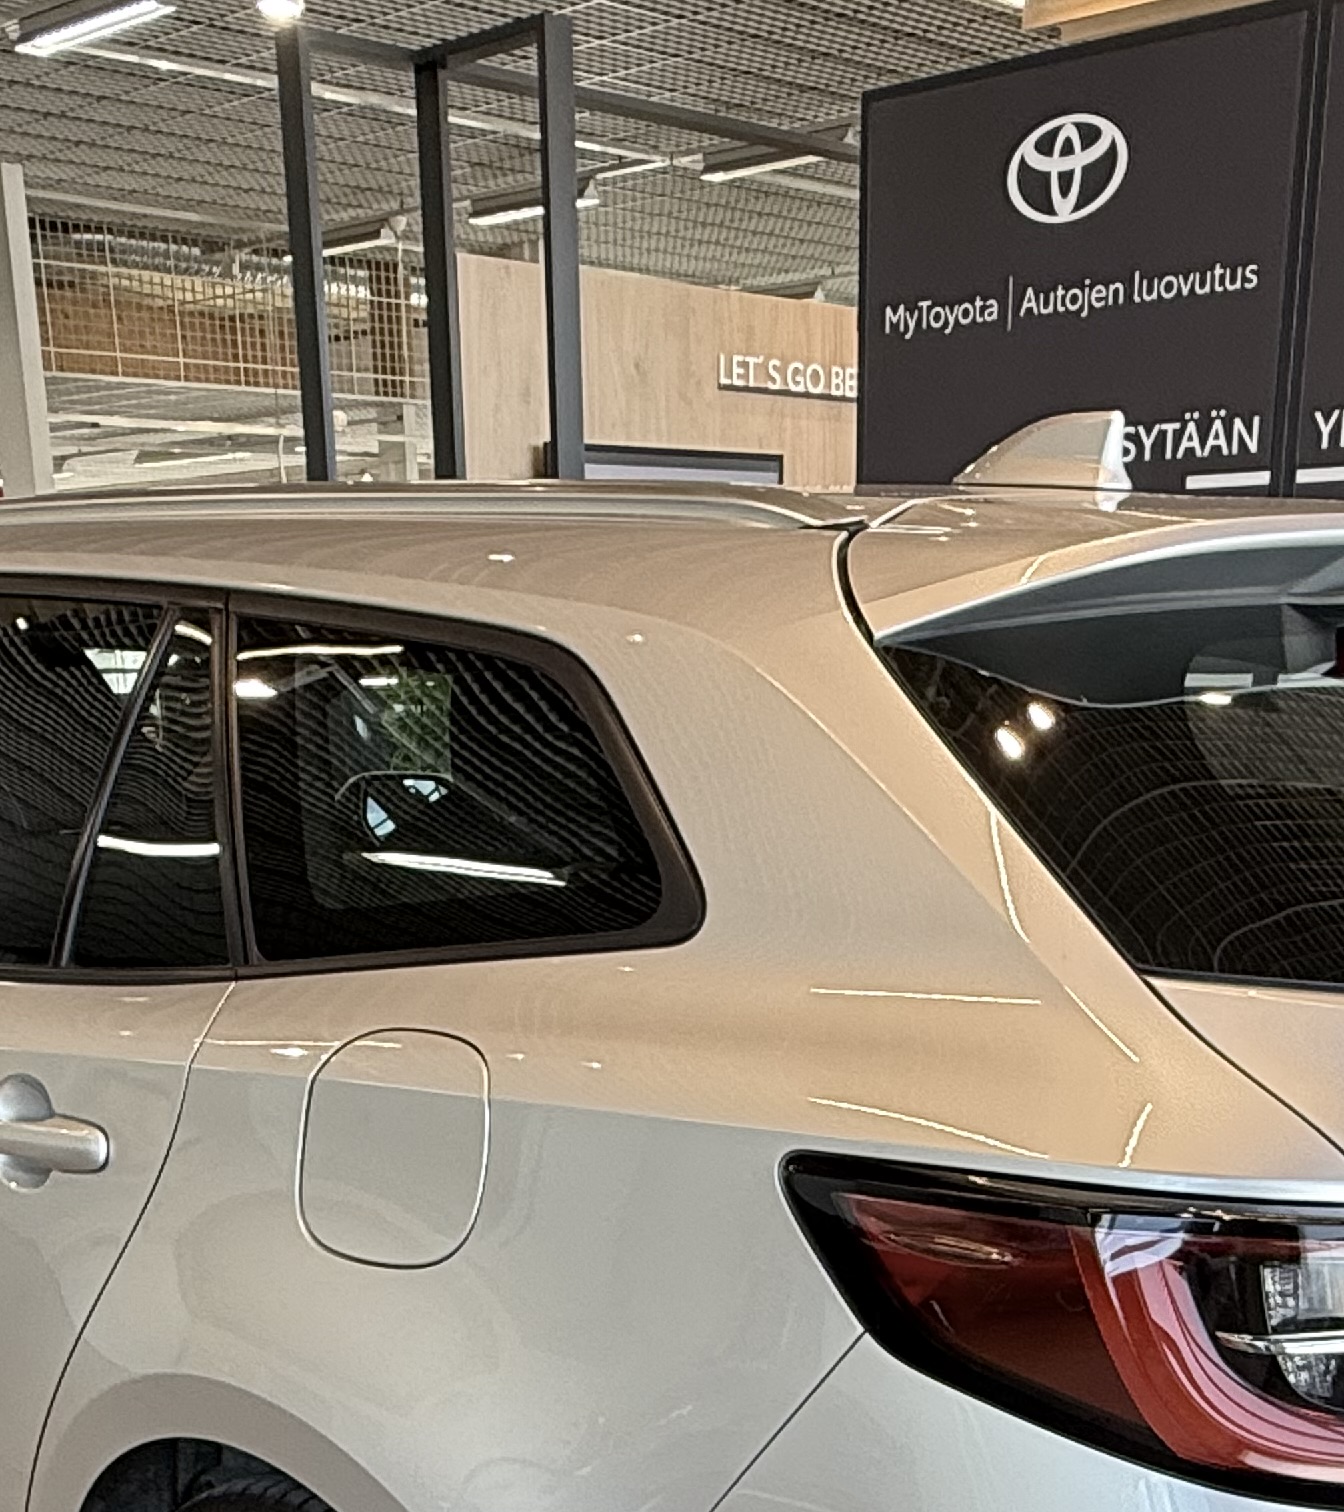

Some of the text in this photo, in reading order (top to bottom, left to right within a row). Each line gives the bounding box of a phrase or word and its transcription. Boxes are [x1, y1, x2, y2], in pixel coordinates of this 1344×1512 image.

[885, 262, 1258, 340] MyToyota Autojen luovutus
[787, 361, 825, 393] GO
